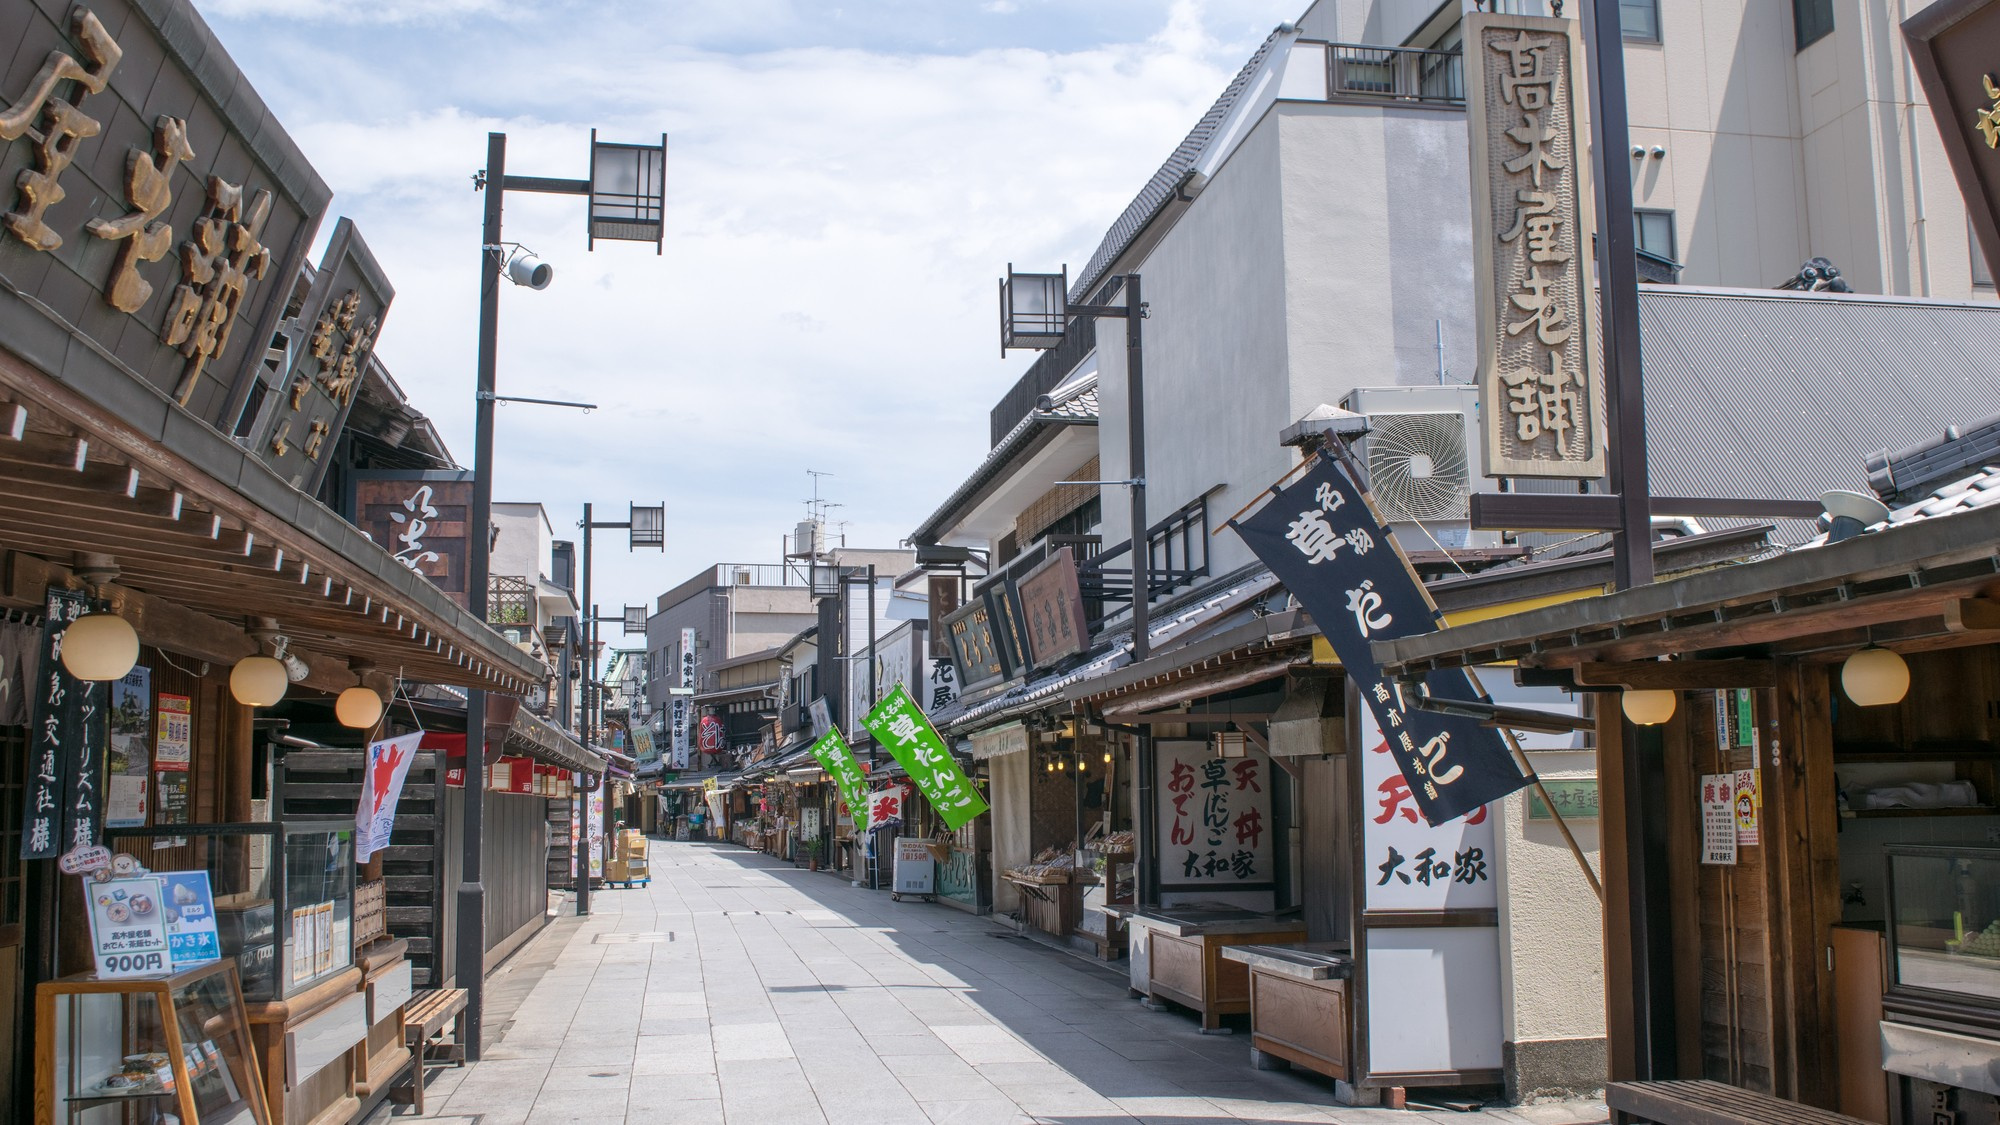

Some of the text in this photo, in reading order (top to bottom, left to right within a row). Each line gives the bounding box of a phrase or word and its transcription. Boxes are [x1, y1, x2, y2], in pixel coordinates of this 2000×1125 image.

[1315, 482, 1375, 556] 名物
[1285, 509, 1464, 786] 草だご
[869, 695, 906, 731] 柴又名物
[701, 721, 727, 751] そば
[814, 733, 839, 758] 柴又名物
[887, 713, 972, 808] 草だんご
[873, 796, 898, 823] 氷
[918, 777, 950, 812] とらや
[1167, 757, 1196, 846] おでん
[1200, 758, 1231, 847] 草だんご
[1231, 758, 1264, 850] 天丼
[1704, 783, 1731, 804] 庚申
[1182, 849, 1258, 880] 大和家
[1376, 845, 1488, 887] 大和家
[102, 938, 163, 950] おでん・茶飯セット
[171, 932, 211, 948] かき氷
[105, 952, 163, 973] 900円
